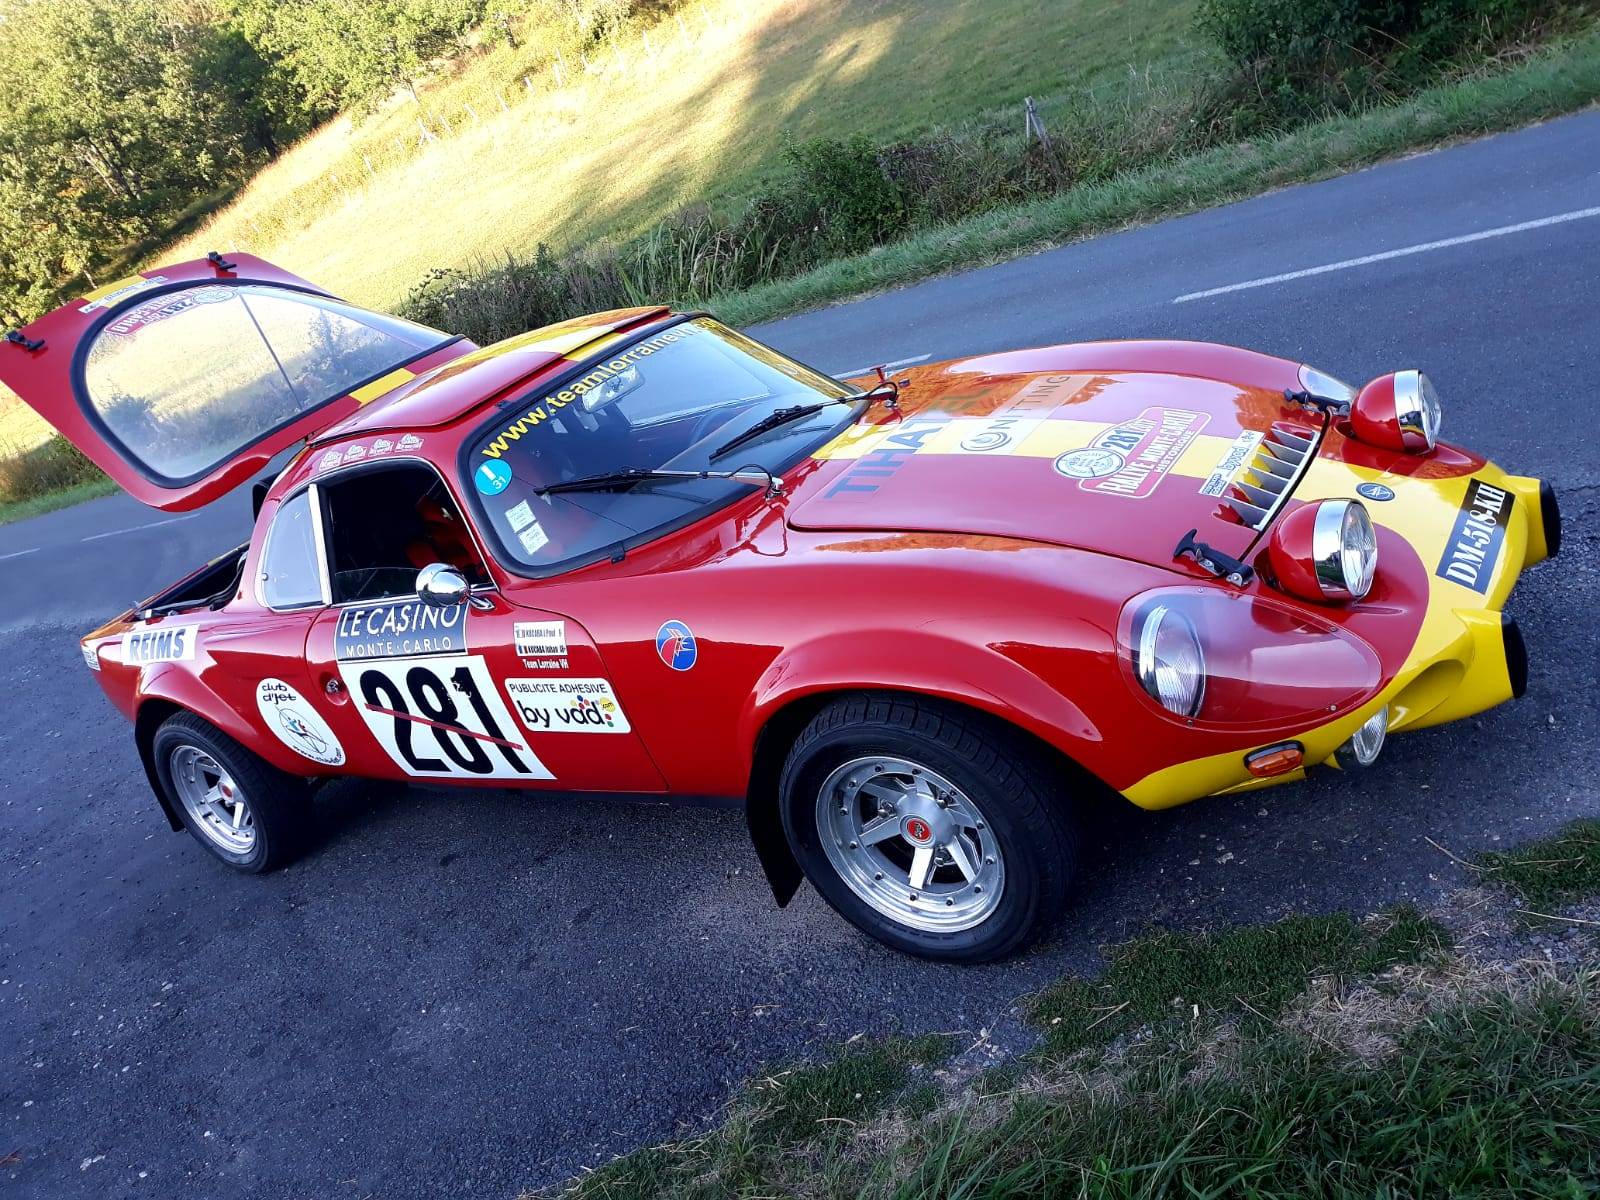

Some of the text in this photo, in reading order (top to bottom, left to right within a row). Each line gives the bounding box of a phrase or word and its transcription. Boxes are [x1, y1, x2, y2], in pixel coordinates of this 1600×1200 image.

[1101, 428, 1145, 450] 281
[1152, 430, 1195, 473] HISTORIQUE
[1095, 462, 1155, 493] RALLYE
[1446, 483, 1506, 587] DM-518-KH
[340, 604, 460, 637] LE CASINO
[129, 628, 187, 661] REIMS
[262, 683, 288, 691] club
[509, 683, 608, 693] PUBLICITE ADHESIVE
[360, 667, 533, 775] 281
[517, 700, 606, 728] by vad
